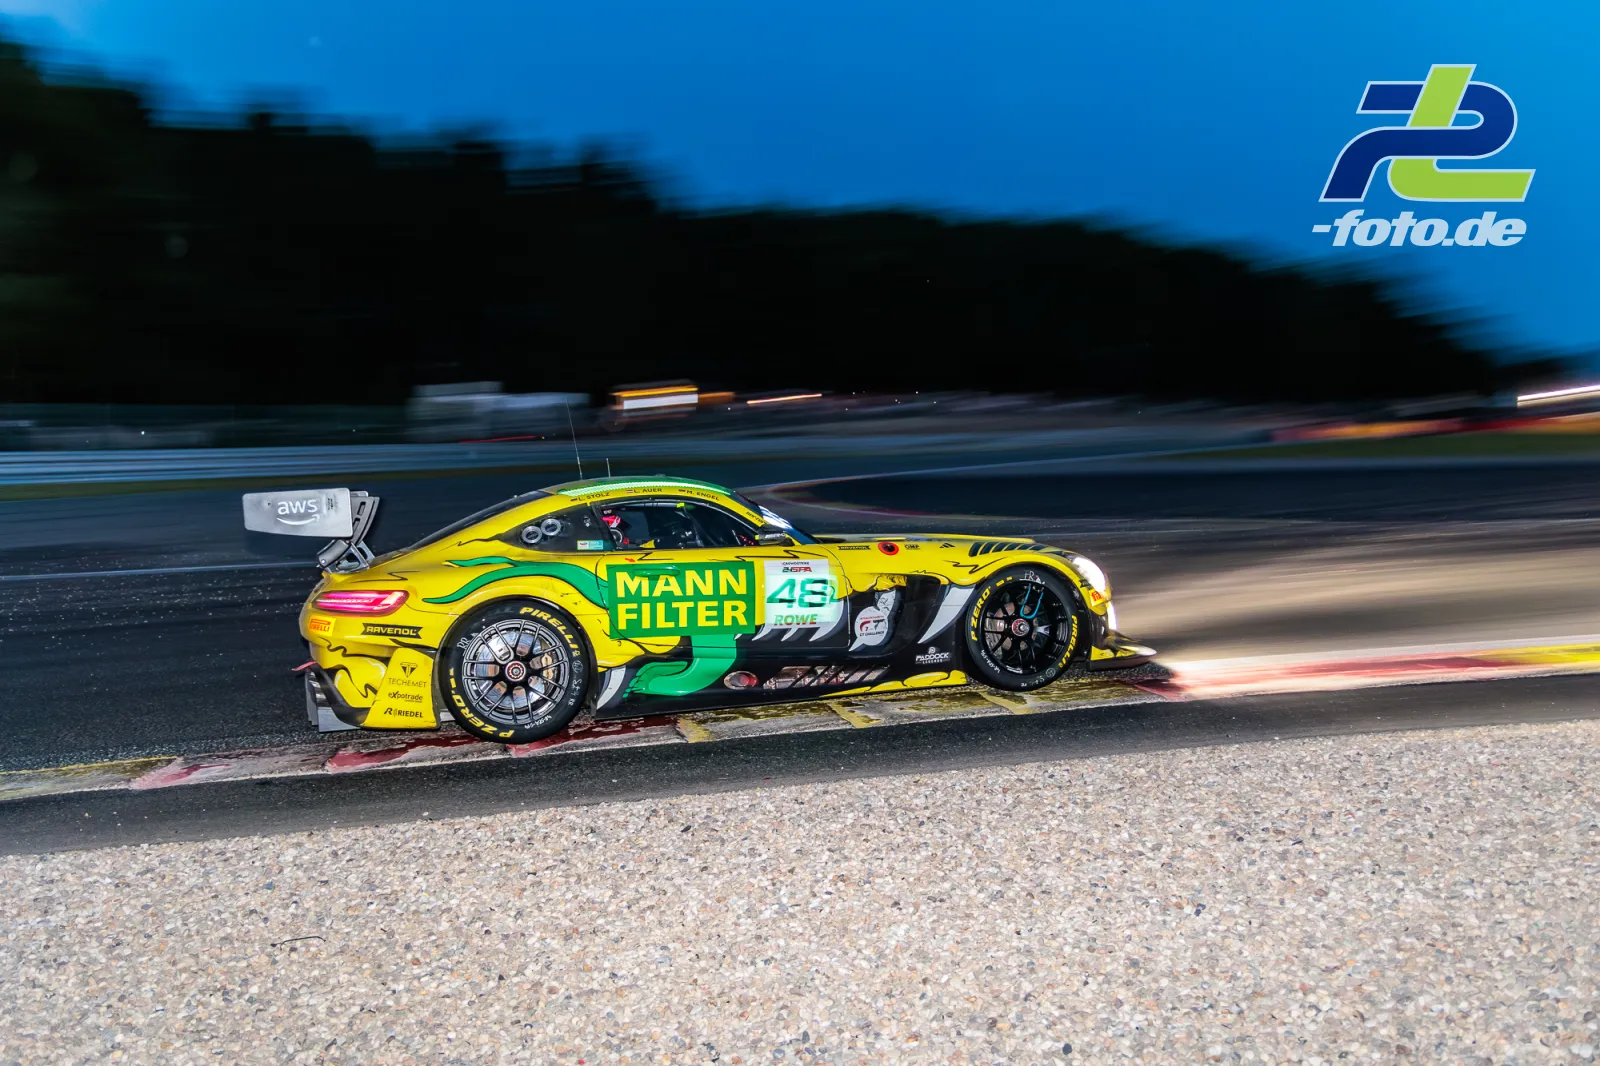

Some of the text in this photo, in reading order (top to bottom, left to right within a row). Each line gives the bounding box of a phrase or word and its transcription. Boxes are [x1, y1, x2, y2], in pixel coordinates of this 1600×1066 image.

[587, 492, 610, 500] STOLZ
[696, 492, 720, 501] ENGEL
[277, 499, 318, 515] aws
[616, 569, 747, 598] MANN
[617, 600, 748, 630] FILTER
[971, 588, 991, 629] ZERO
[773, 613, 818, 626] ROWE
[366, 625, 417, 636] RAVENOL
[519, 606, 579, 650] PIRELLI
[1064, 615, 1078, 665] PIRELLI
[915, 652, 949, 661] PADDOCK
[388, 677, 427, 688] TECHEMET
[397, 709, 424, 718] RIEDEL
[452, 694, 498, 735] ZERO
